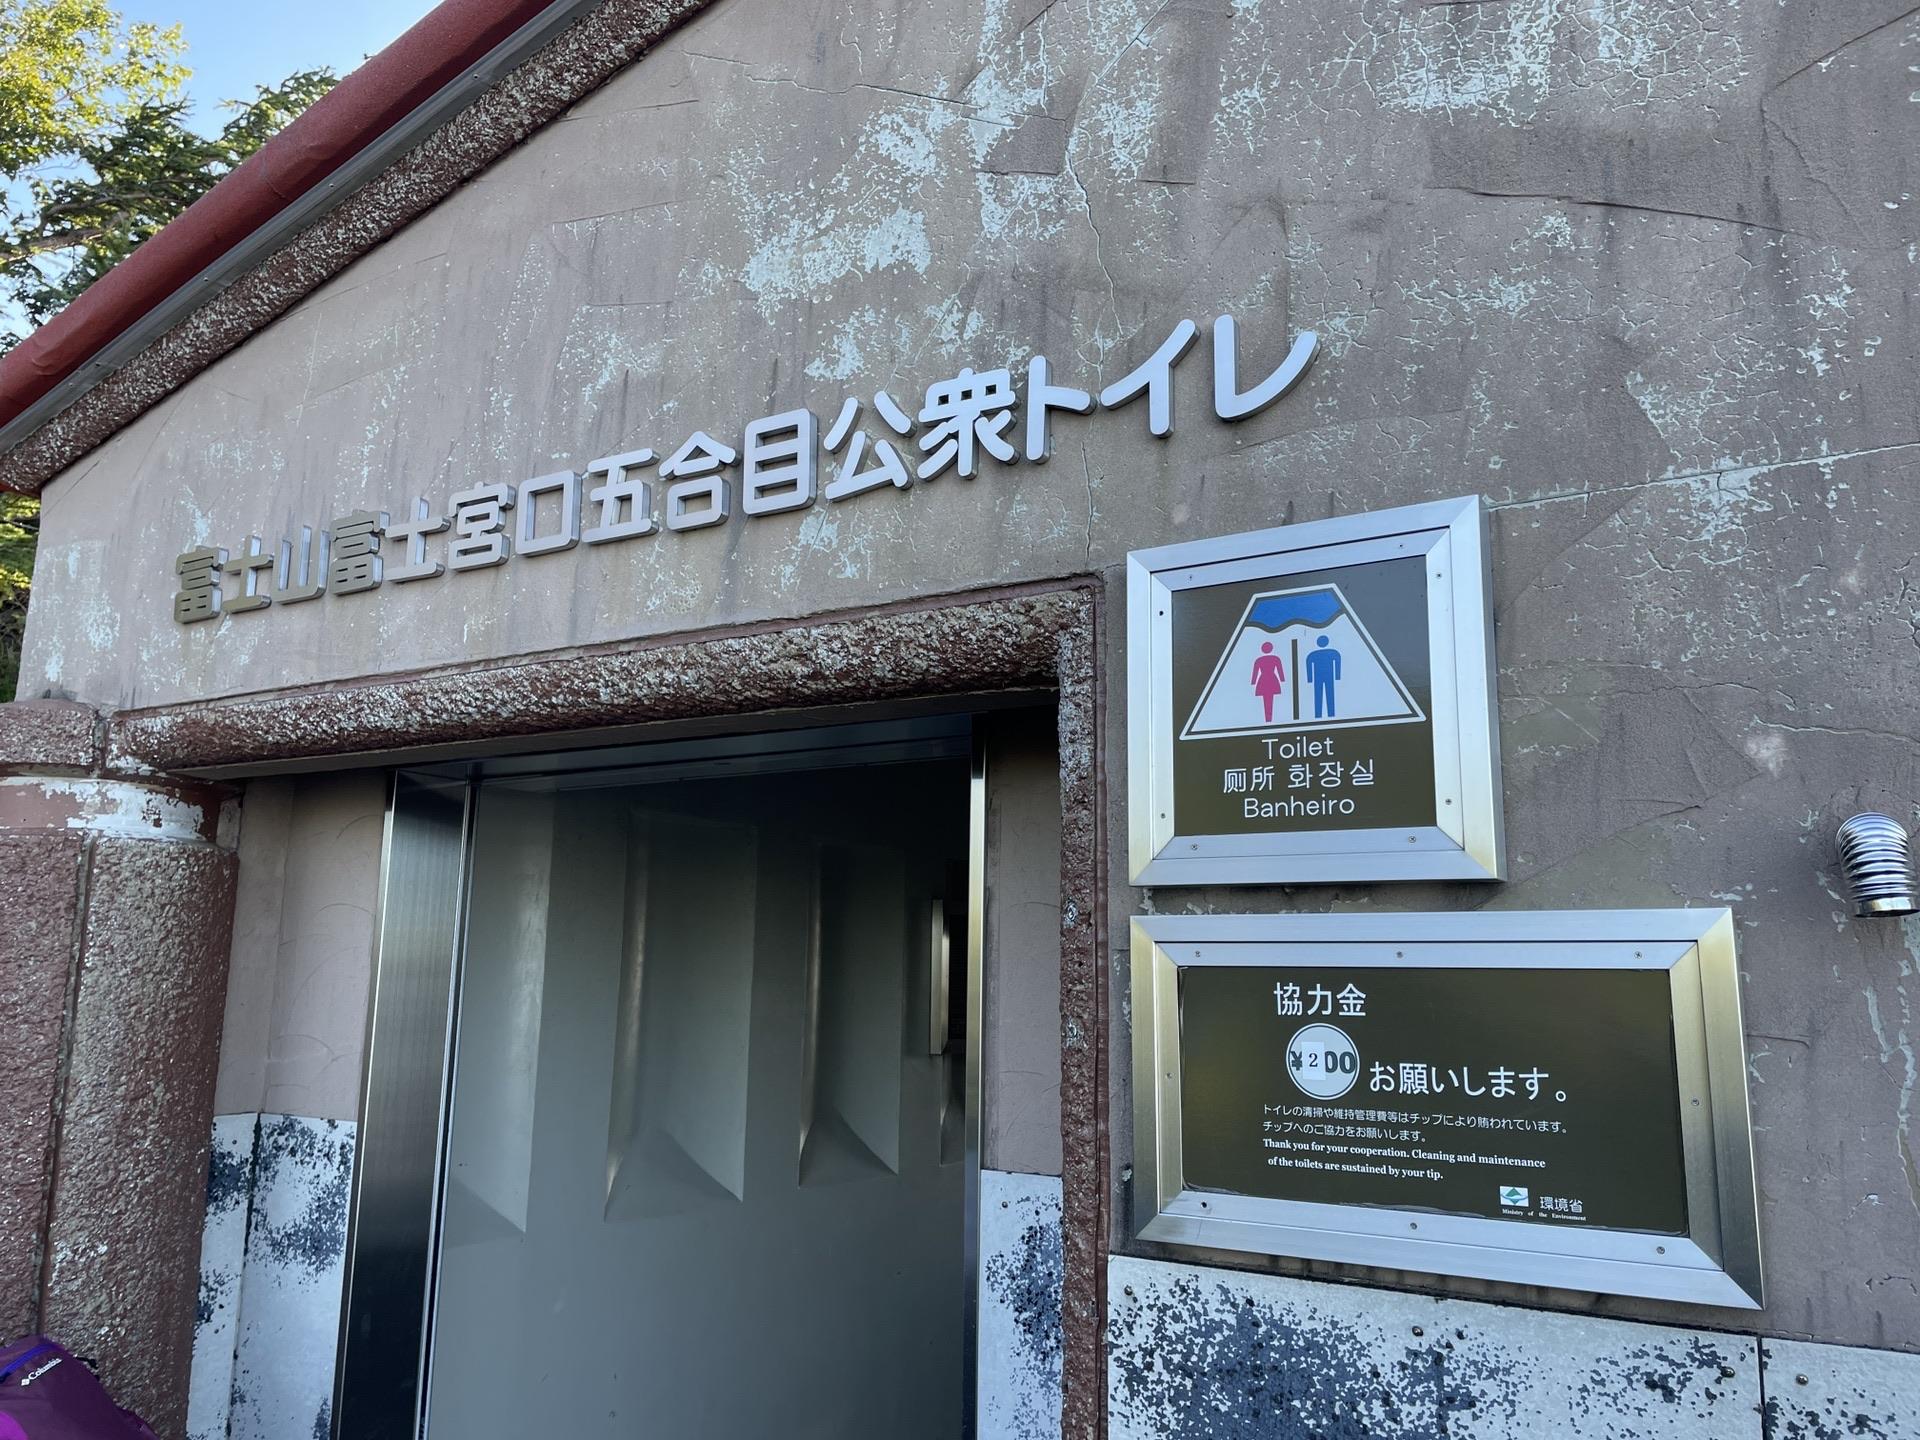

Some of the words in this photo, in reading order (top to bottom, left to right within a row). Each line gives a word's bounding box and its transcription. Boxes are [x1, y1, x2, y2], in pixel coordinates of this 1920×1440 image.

[174, 314, 1321, 625] 富士山富士宮口五合目公衆トイレ
[1261, 736, 1334, 760] Toilet
[1222, 765, 1275, 793] 厕所
[1287, 759, 1375, 789] 화장실
[1244, 794, 1355, 818] Banheiro
[1273, 981, 1367, 1017] 協力金
[1369, 1060, 1567, 1102] お願いします。
[1262, 1120, 1426, 1143] チップへのご協力をお願いします。
[1263, 1138, 1291, 1149] Thank
[1292, 1141, 1310, 1152] you
[1311, 1141, 1326, 1151] for
[1326, 1144, 1348, 1154] your
[1349, 1146, 1410, 1158] cooperation.
[1411, 1149, 1455, 1163] Cleaning
[1456, 1153, 1476, 1163] and
[1478, 1154, 1546, 1168] maintenance
[1267, 1156, 1279, 1166] of
[1278, 1157, 1293, 1167] the
[1294, 1158, 1323, 1170] toilets
[1324, 1163, 1340, 1171] are
[1341, 1163, 1387, 1175] sustained
[1388, 1165, 1400, 1177] by
[1401, 1168, 1425, 1178] your
[1426, 1168, 1444, 1181] tip.
[1502, 1208, 1524, 1216] Ministry
[1551, 1213, 1586, 1221] Environment
[1540, 1196, 1583, 1213] 環境省
[28, 1358, 62, 1380] Columbia
